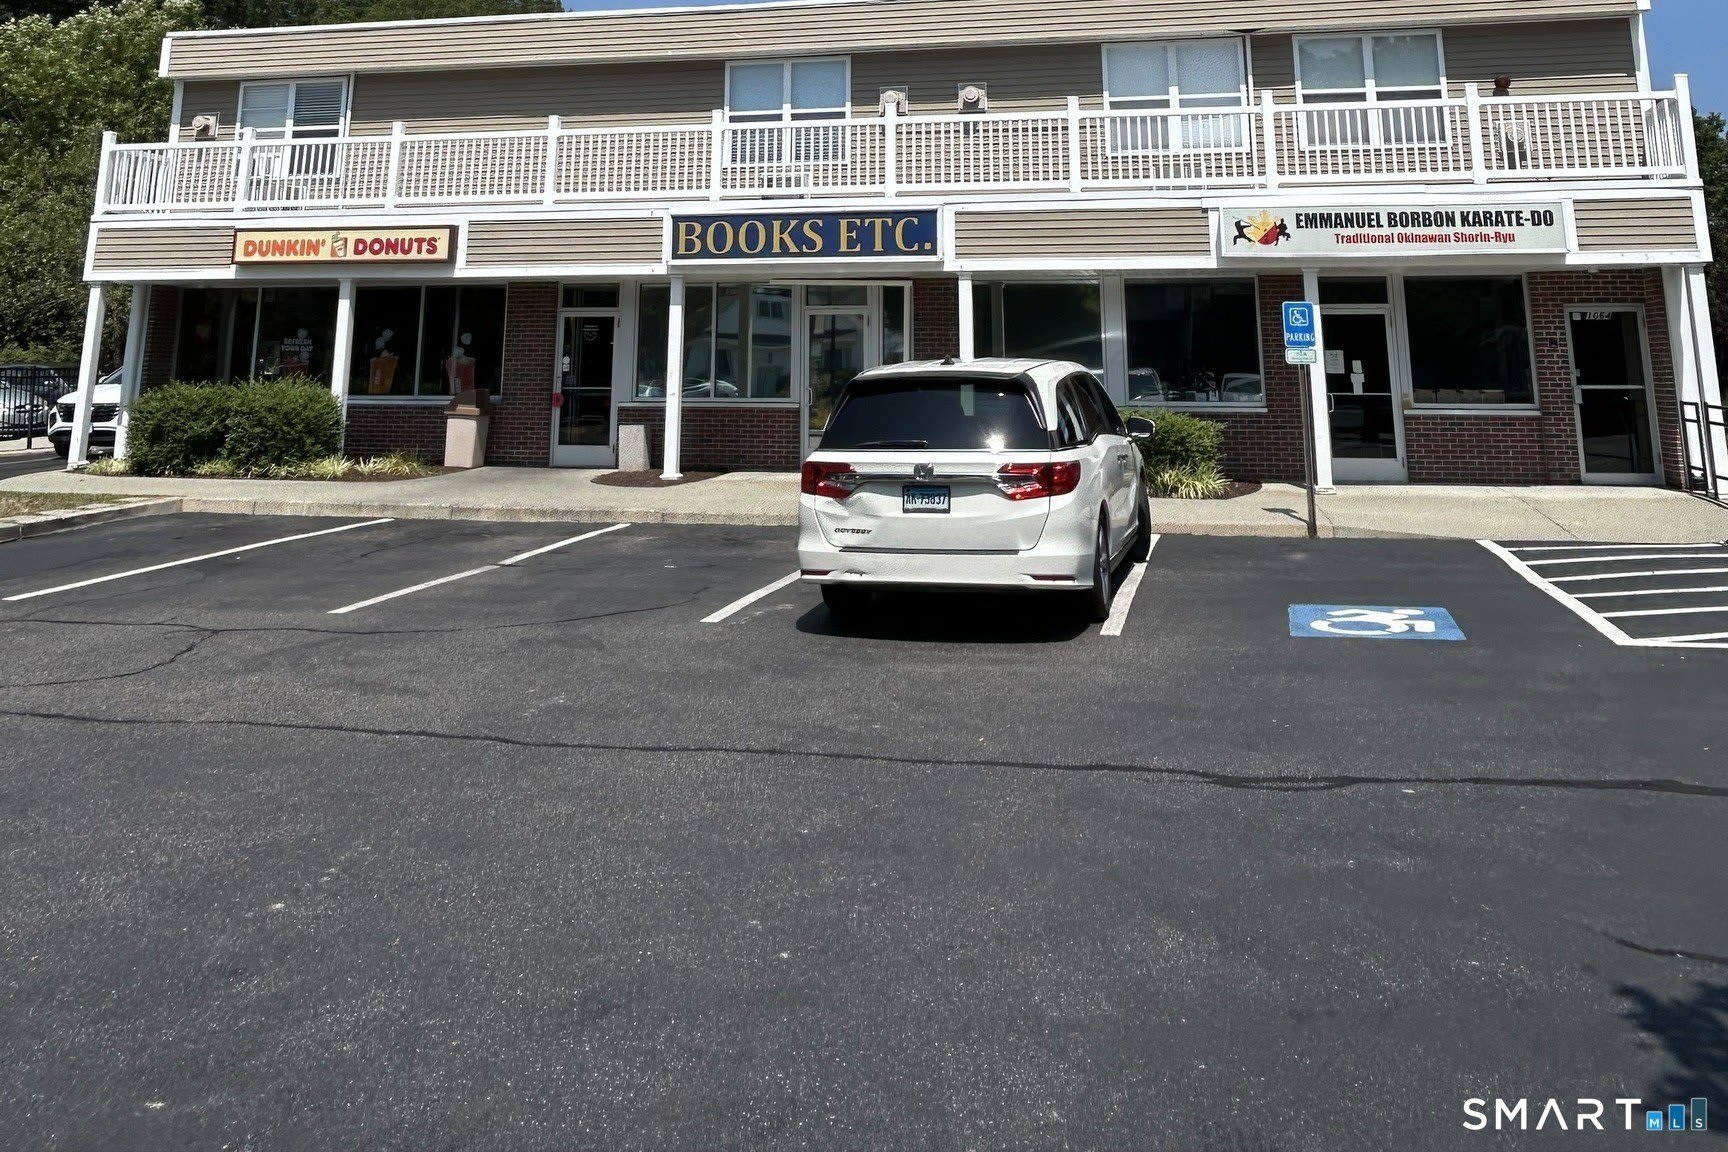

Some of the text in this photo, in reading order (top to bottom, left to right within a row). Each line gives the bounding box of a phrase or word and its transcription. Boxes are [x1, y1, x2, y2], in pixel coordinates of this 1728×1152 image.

[1295, 210, 1554, 229] EMMANUEL BORBON KARATE-DO
[677, 217, 932, 255] BOOKS ETC.
[1334, 231, 1516, 244] Traditional Okinawan Shorin-Ryu
[243, 237, 438, 257] DUNKIN' DONUTS
[1286, 332, 1315, 342] PARKING
